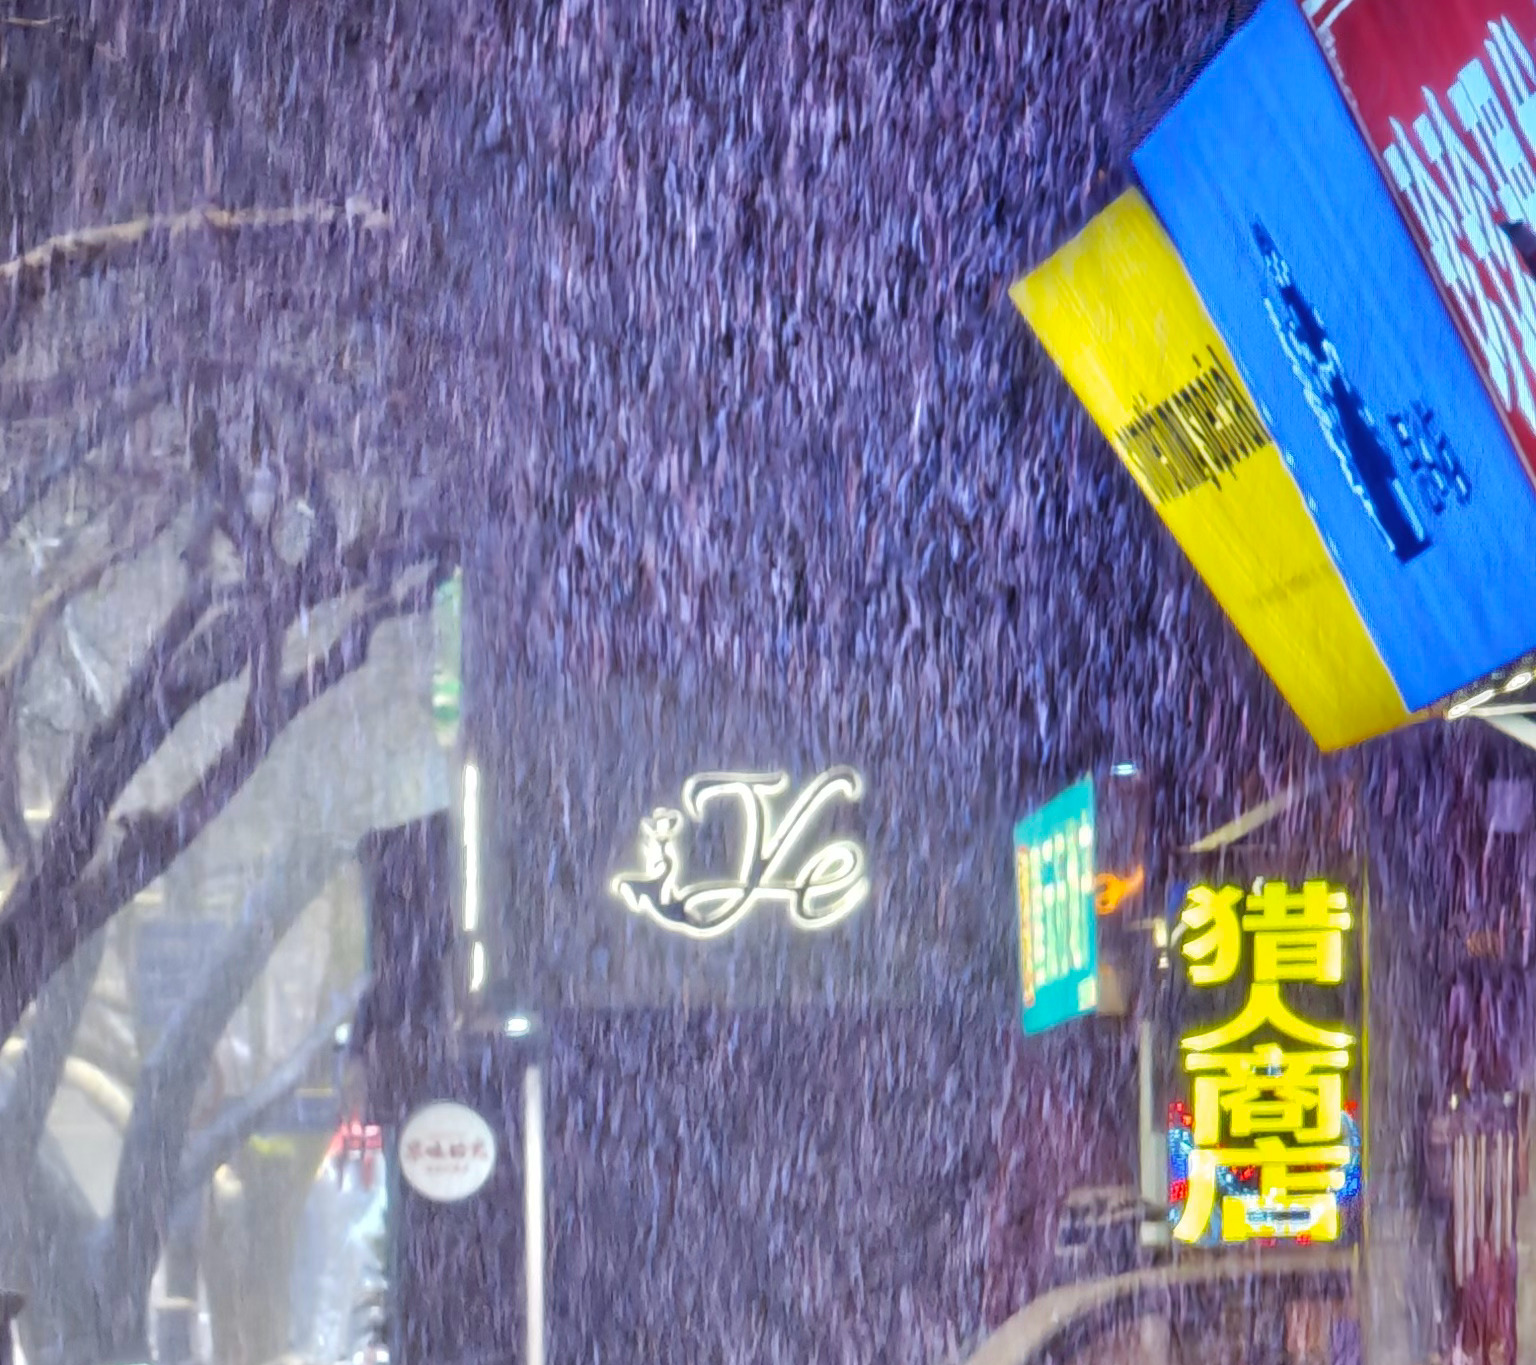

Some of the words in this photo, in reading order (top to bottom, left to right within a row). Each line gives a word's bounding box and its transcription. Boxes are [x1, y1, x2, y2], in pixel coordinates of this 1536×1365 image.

[1170, 344, 1273, 482] special
[1173, 878, 1356, 1243] 猎人商店
